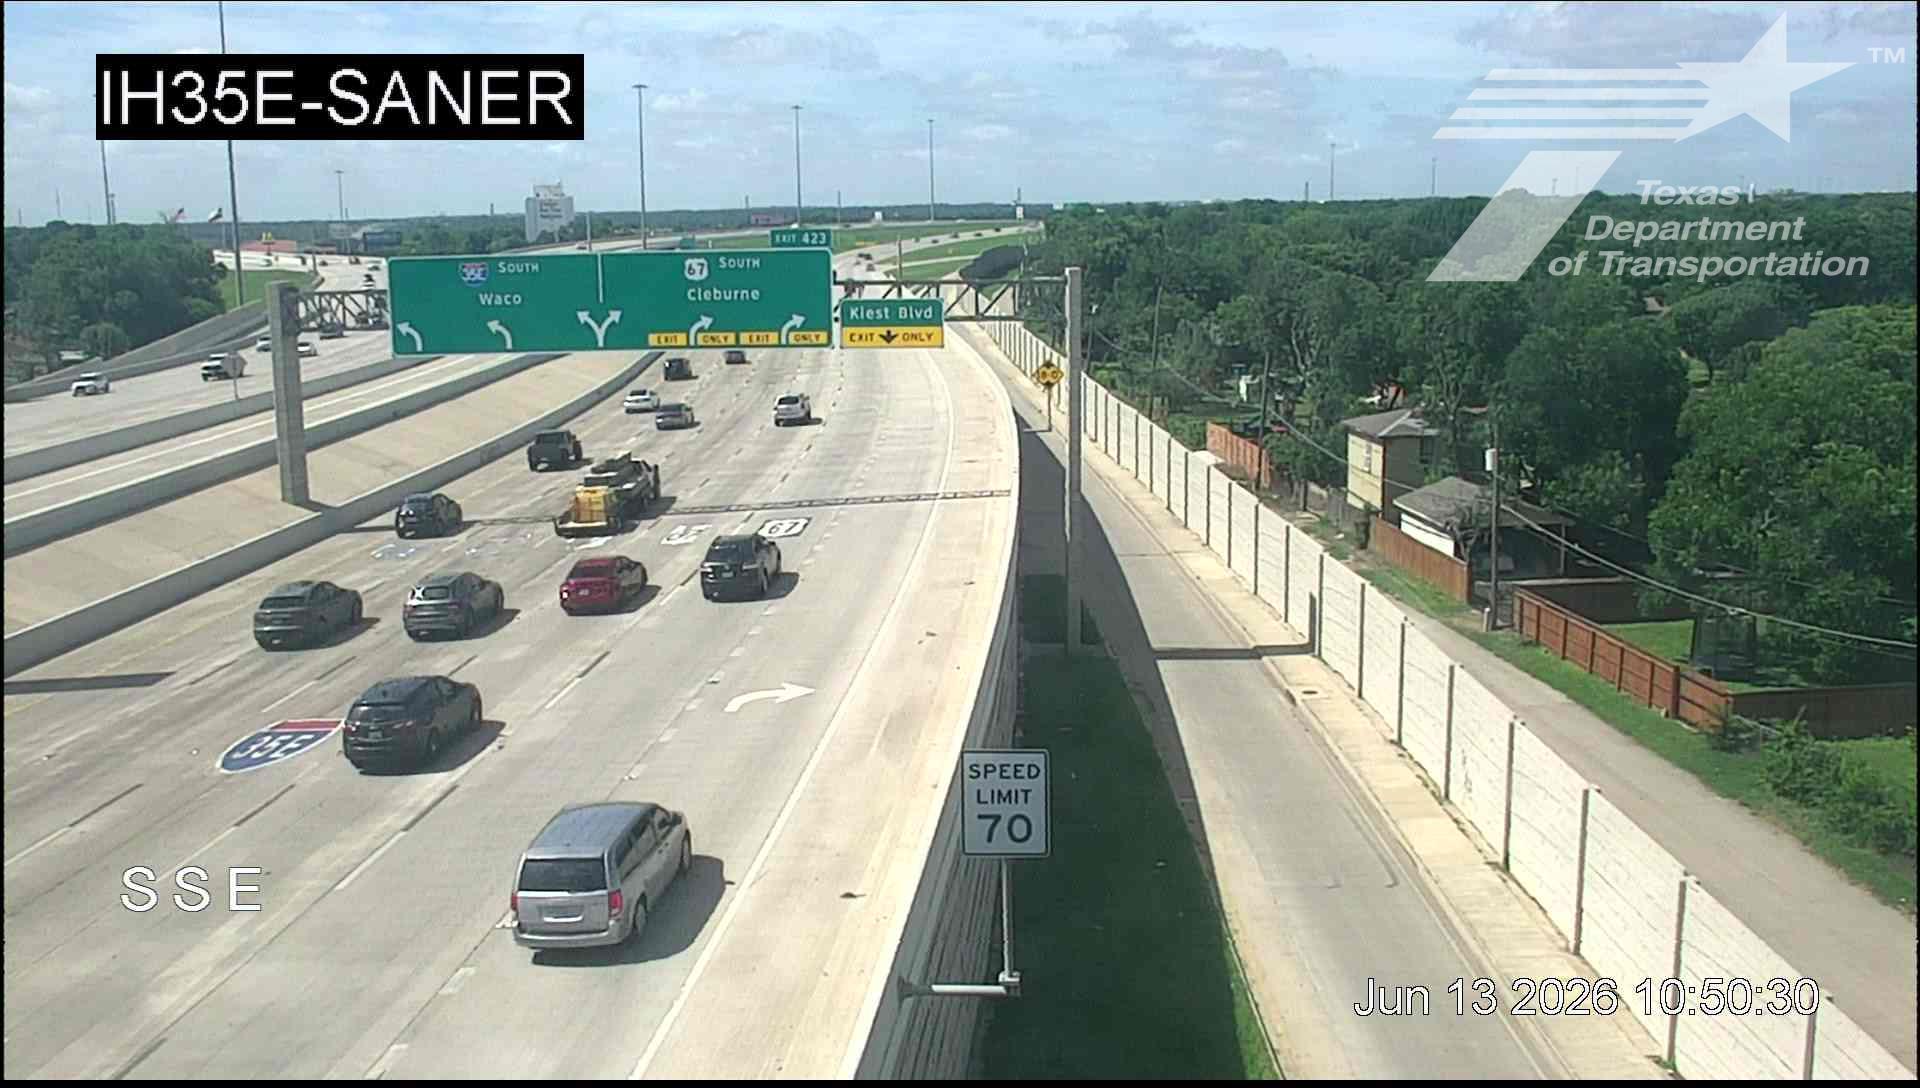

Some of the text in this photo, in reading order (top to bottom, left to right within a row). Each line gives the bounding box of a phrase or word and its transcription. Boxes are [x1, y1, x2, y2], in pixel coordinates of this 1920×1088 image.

[775, 232, 826, 244] EXIT 423
[687, 263, 706, 276] 67
[479, 293, 522, 305] Waco
[687, 288, 760, 301] Cleburne
[898, 305, 933, 320] Blvd
[657, 333, 821, 344] EXIT ONLY EXIT ONLY
[849, 332, 933, 343] EXIT ONLY
[768, 522, 800, 534] 67
[231, 734, 315, 759] 35E
[968, 763, 1041, 780] SPEED
[976, 788, 1033, 805] LIMIT
[977, 813, 1033, 844] 70
